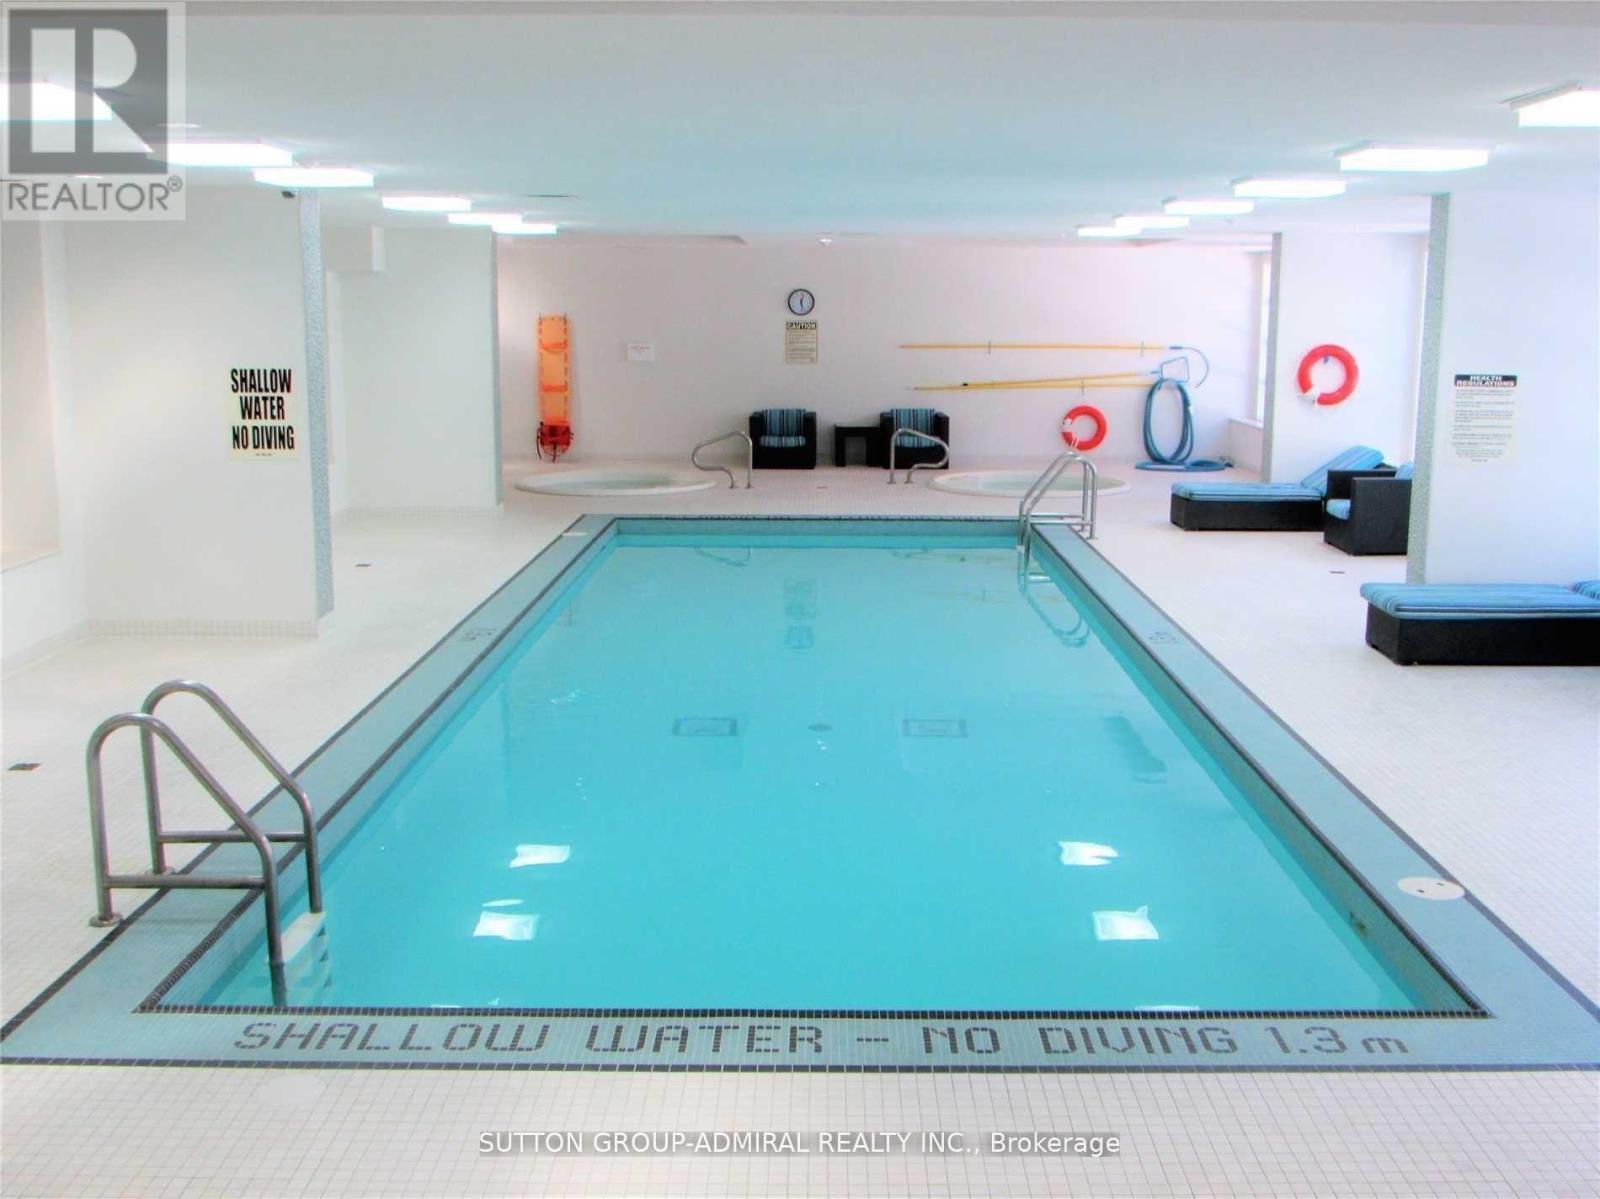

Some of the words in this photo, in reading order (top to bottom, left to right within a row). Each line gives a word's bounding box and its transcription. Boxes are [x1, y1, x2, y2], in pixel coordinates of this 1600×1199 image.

[787, 322, 817, 330] CAUTION
[230, 368, 292, 393] SHALLOW
[1456, 380, 1515, 388] REGULATIONS
[240, 396, 285, 420] WATER
[232, 425, 249, 450] NO
[252, 425, 295, 450] DIVING
[234, 1022, 548, 1051] SHALLOW
[585, 1024, 823, 1053] WATER
[923, 1026, 1000, 1054] NO
[1039, 1026, 1238, 1055] DIVING
[1264, 1026, 1348, 1054] 1.3
[1361, 1037, 1410, 1054] m
